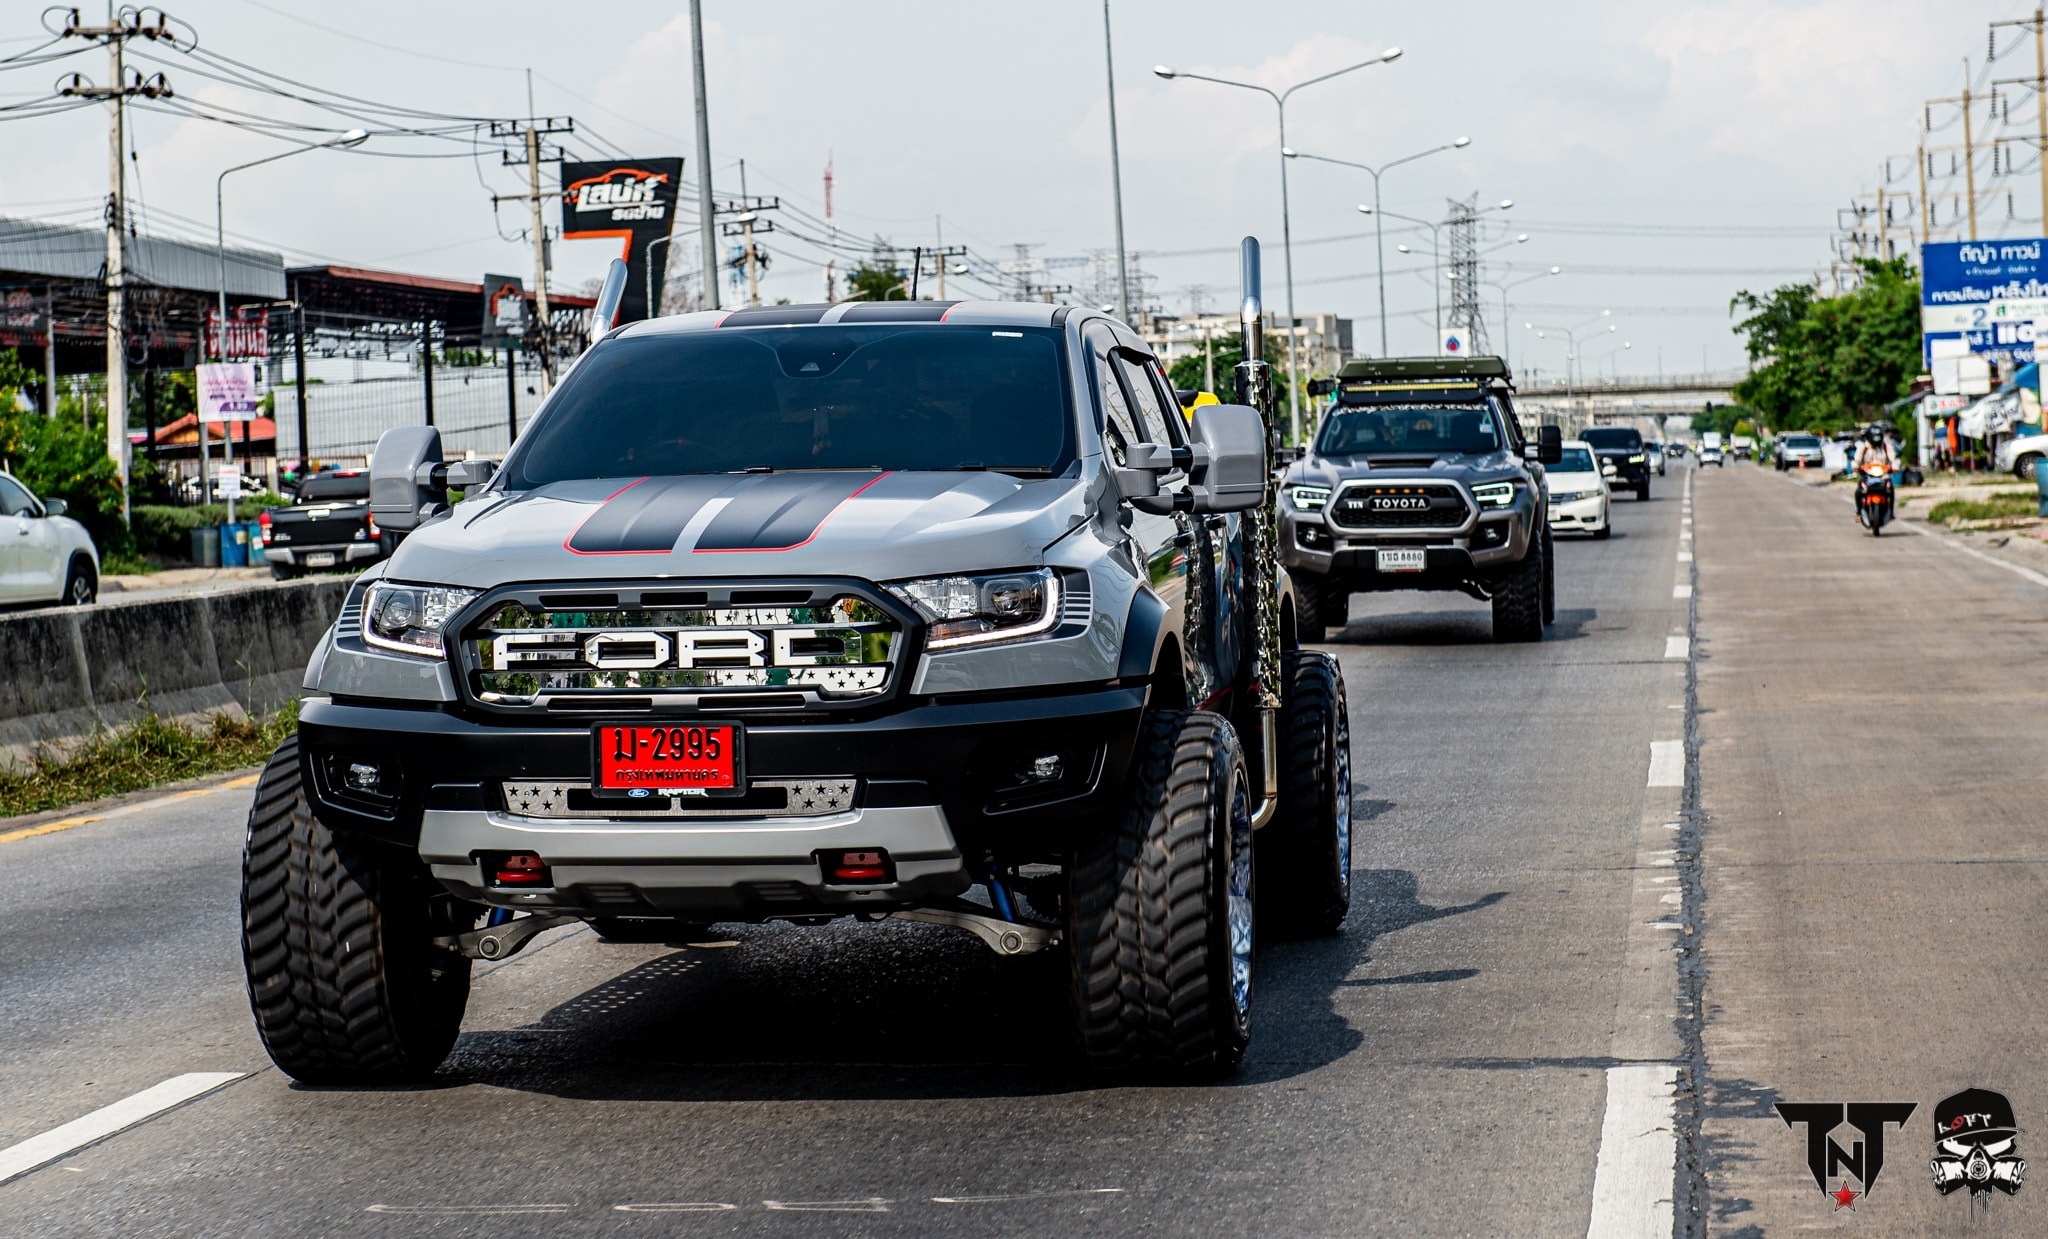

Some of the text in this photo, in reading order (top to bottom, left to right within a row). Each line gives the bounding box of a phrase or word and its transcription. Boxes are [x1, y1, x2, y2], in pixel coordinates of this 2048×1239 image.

[1972, 307, 1987, 327] 2
[1374, 498, 1427, 509] TOYOTA
[493, 629, 863, 671] FORD
[615, 768, 719, 783] กรุงเทพมหานคร
[658, 788, 709, 797] RAPTOR
